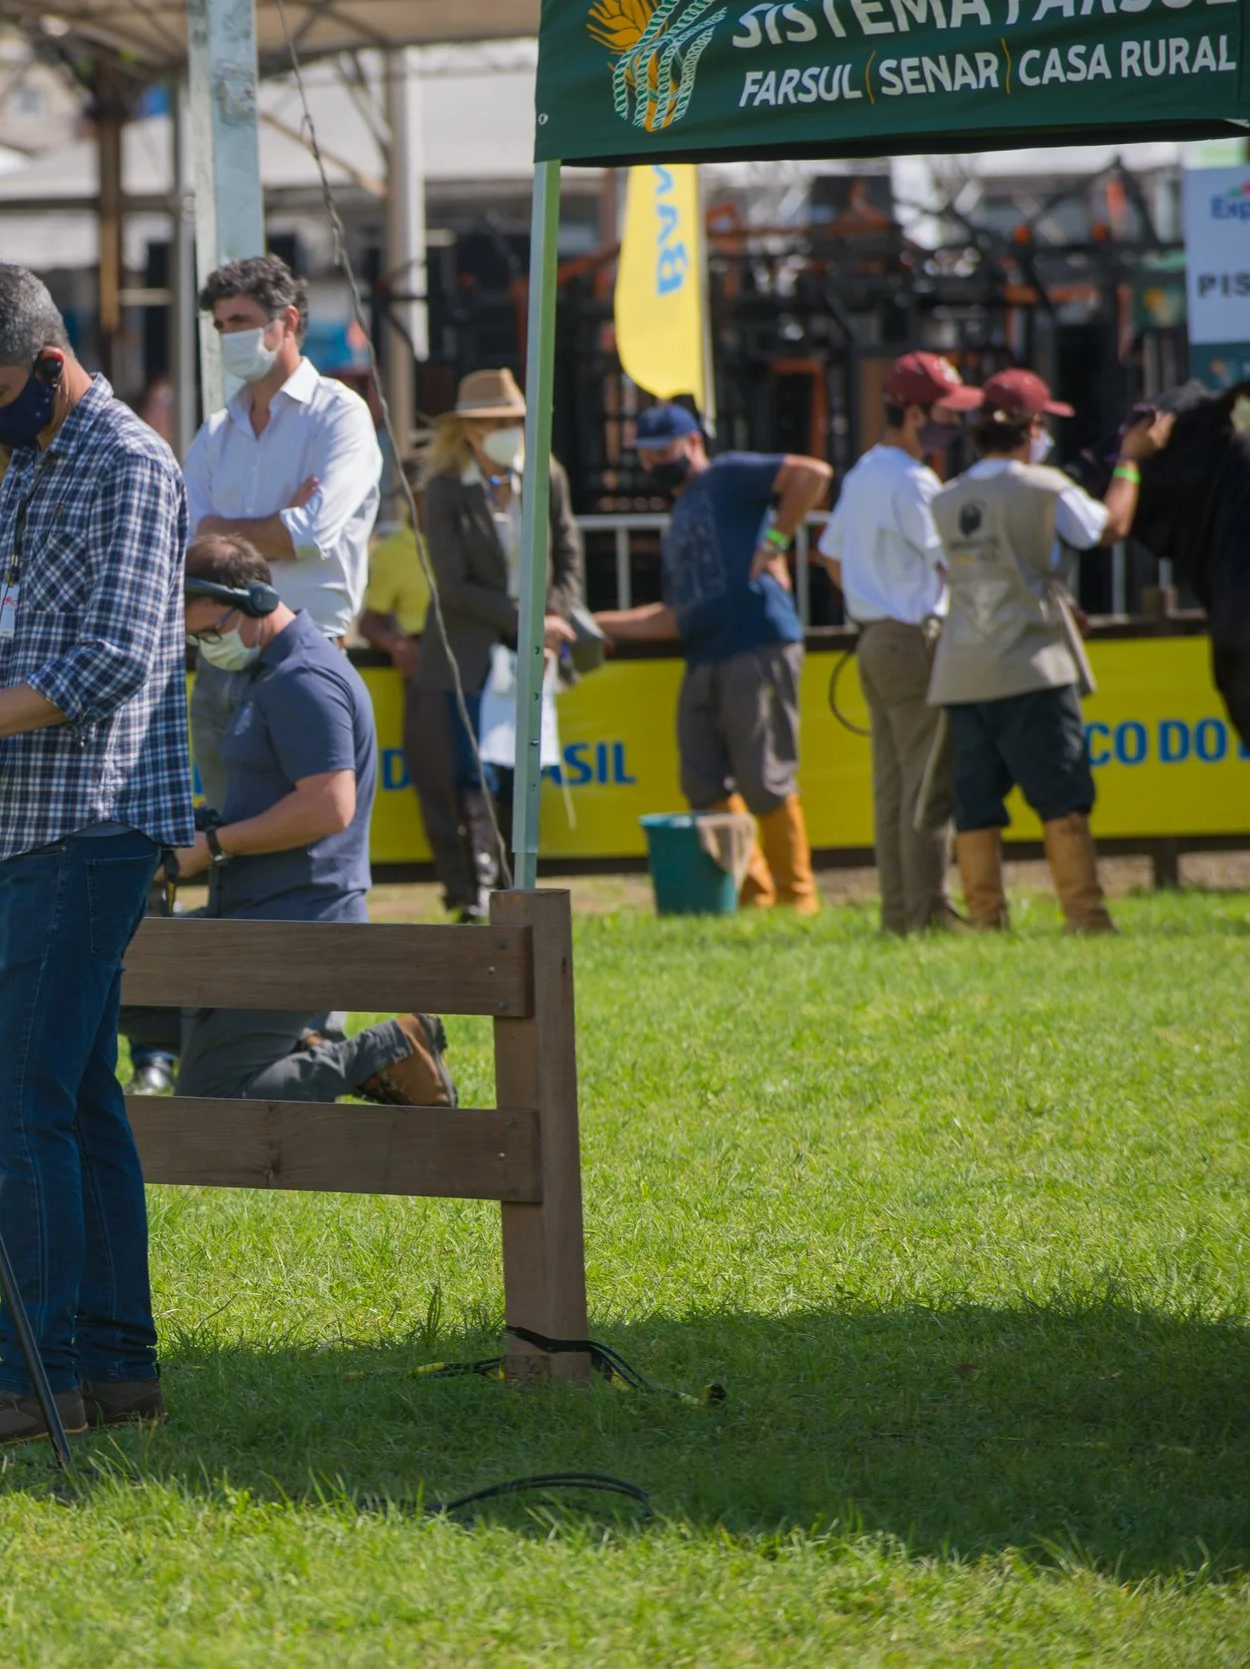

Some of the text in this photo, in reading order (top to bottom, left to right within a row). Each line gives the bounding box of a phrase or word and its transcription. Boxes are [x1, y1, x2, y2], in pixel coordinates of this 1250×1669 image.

[732, 0, 991, 48] SISTEMA
[739, 35, 1237, 107] FARSUL SENAR CASA RURAL
[1158, 717, 1227, 764] DO
